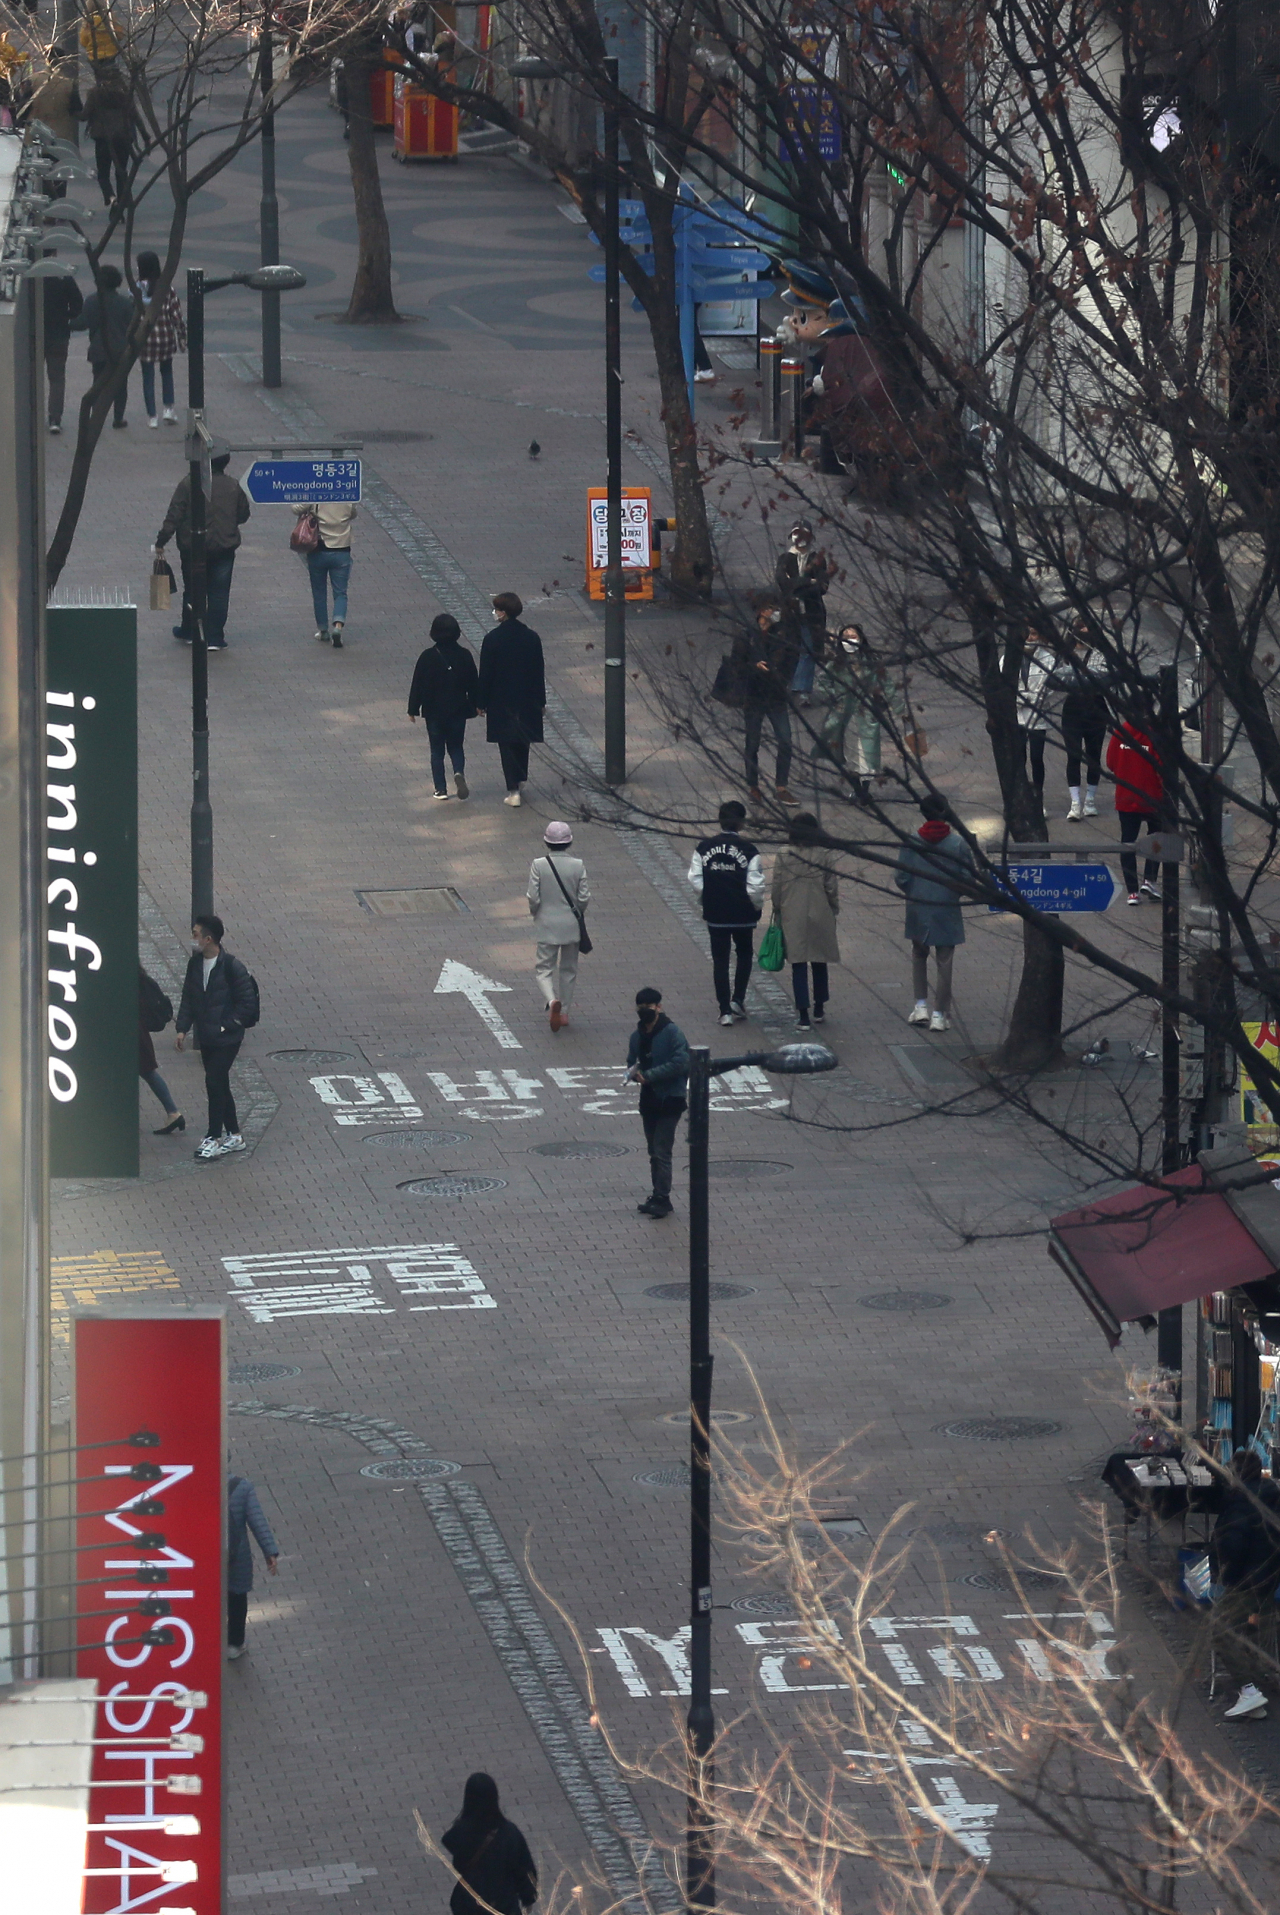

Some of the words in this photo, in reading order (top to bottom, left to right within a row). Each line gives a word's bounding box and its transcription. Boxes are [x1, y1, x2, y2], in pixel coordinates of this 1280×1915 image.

[312, 463, 357, 477] 명동3길
[272, 480, 333, 491] Myeongdong
[335, 480, 357, 490] 3-gil
[711, 861, 736, 871] School
[993, 867, 1043, 884] 동4길
[1096, 874, 1107, 882] 50
[1062, 887, 1086, 899] 4-gil
[104, 1464, 194, 1915] MISSHA
